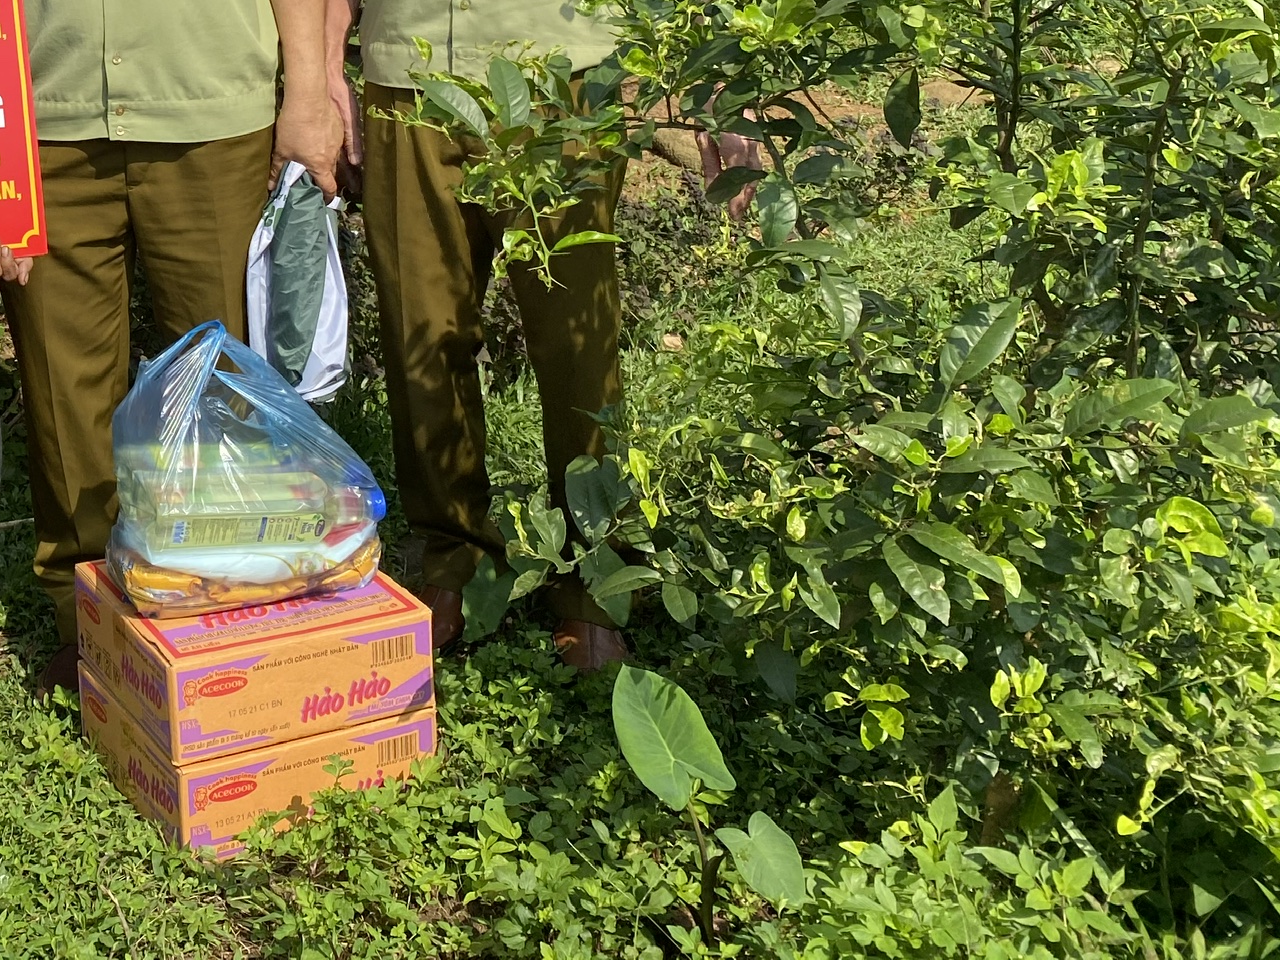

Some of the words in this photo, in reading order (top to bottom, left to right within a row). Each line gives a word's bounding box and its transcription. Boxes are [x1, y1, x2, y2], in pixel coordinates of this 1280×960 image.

[252, 663, 265, 672] SẢN
[265, 658, 282, 669] PHẨM
[294, 654, 312, 664] CÔNG
[312, 649, 328, 659] NGHỆ
[197, 673, 214, 685] Cook
[214, 668, 248, 677] happiness
[300, 686, 345, 724] Hảo
[347, 670, 391, 707] Hảo
[228, 709, 237, 718] 17
[238, 707, 248, 716] 05
[249, 705, 257, 714] 21
[259, 702, 269, 711] C1
[271, 699, 283, 709] BN
[262, 768, 274, 777] SẢN
[275, 763, 291, 773] PHẨM
[303, 756, 319, 766] CÔNG
[208, 778, 223, 790] Cook
[225, 773, 257, 782] happiness
[215, 820, 224, 828] 13
[225, 817, 235, 826] 05
[235, 814, 245, 823] 21
[247, 810, 256, 819] A1
